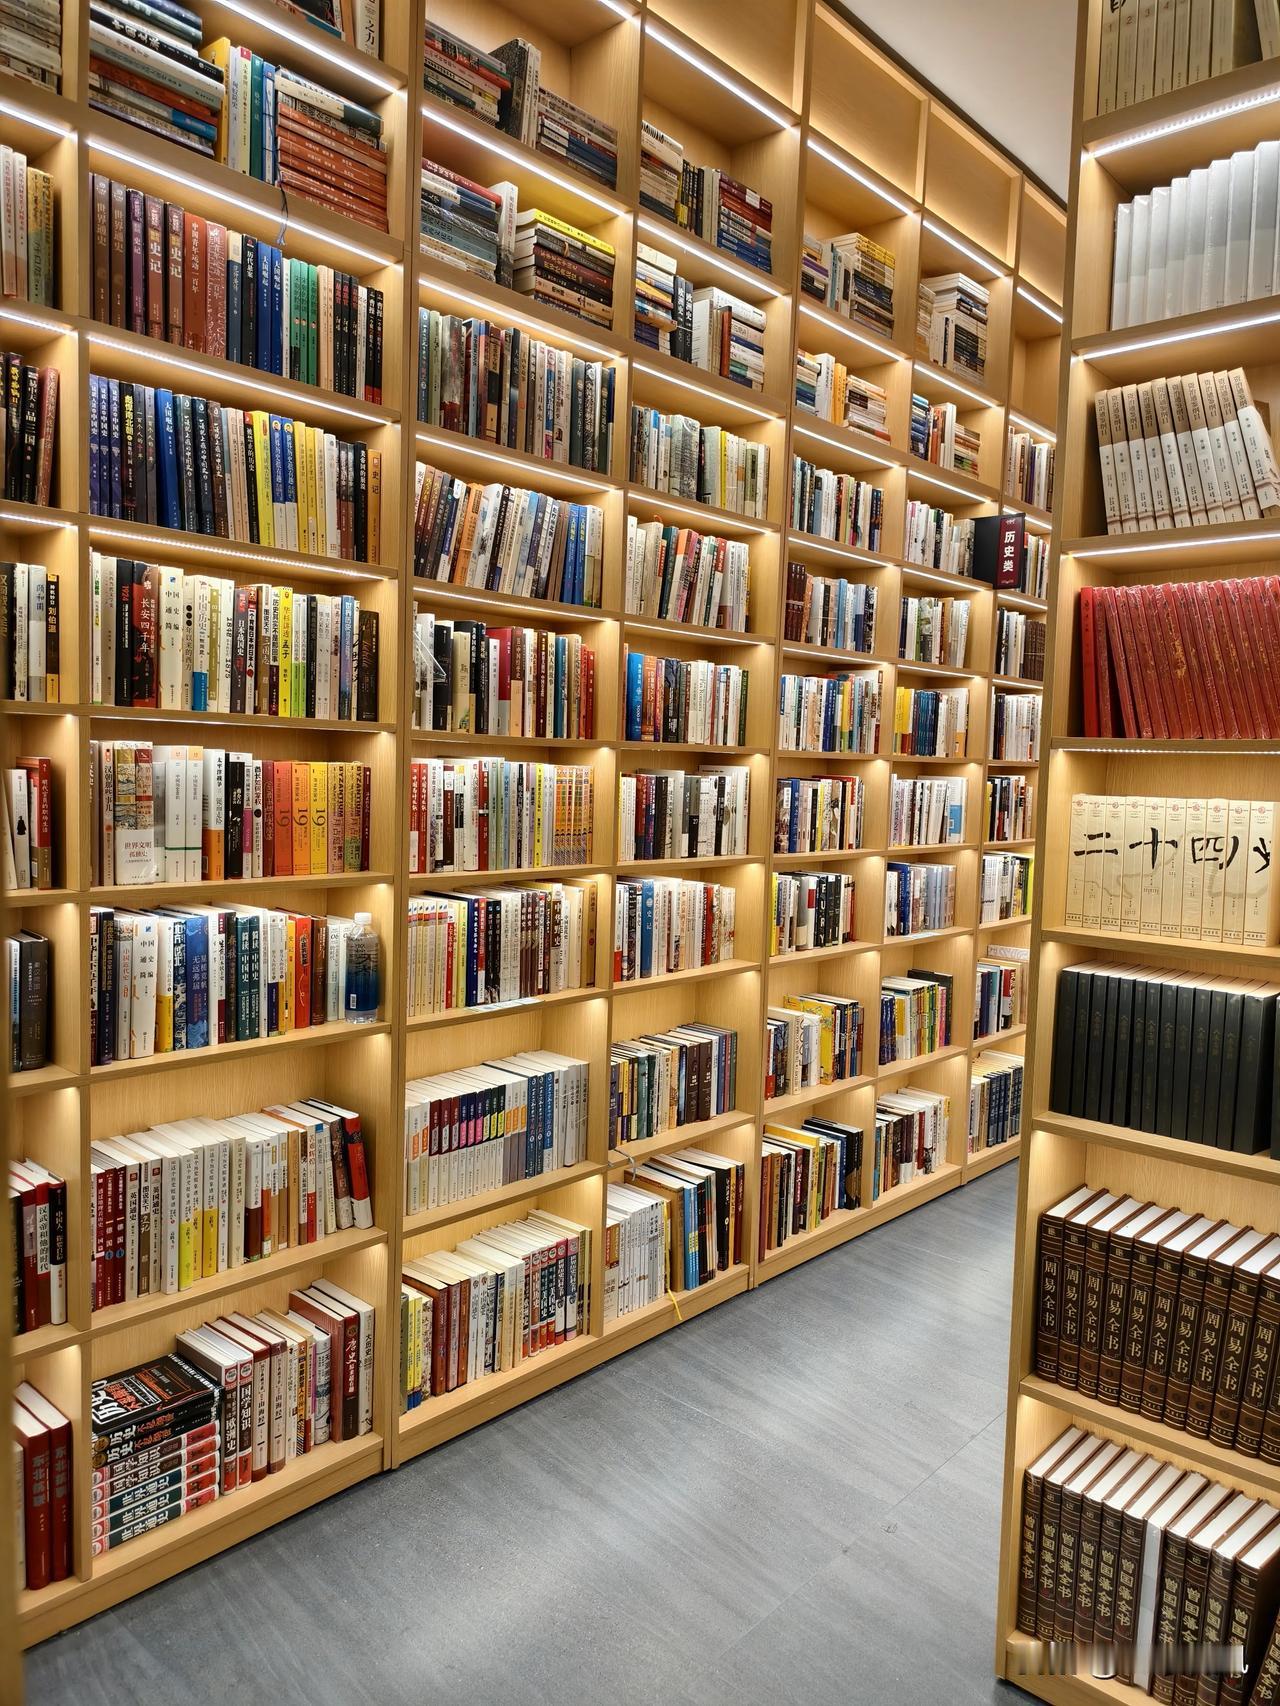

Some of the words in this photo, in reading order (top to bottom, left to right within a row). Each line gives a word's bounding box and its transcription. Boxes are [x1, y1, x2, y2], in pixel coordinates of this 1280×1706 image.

[150, 242, 162, 274] 史记
[170, 247, 183, 278] 史记
[1003, 531, 1016, 572] 历史类
[140, 598, 151, 653] 长安四千年
[294, 807, 309, 826] 19
[312, 808, 326, 826] 19
[1043, 1259, 1057, 1328] 周易全书
[1064, 1267, 1079, 1336] 周易全书
[1085, 1275, 1100, 1344] 周易全书
[1106, 1282, 1123, 1351] 周易全书
[1128, 1289, 1147, 1358] 周易全书
[1150, 1296, 1170, 1366] 周易全书
[1176, 1303, 1196, 1374] 周易全书
[1200, 1311, 1220, 1382] 周易全书
[1224, 1319, 1246, 1392] 周易全书
[1248, 1326, 1273, 1400] 周易全书
[240, 1386, 251, 1431] 国学知识
[113, 1446, 161, 1477] 国学知识
[113, 1461, 161, 1494] 国学知识
[122, 1476, 170, 1507] 世界通史
[121, 1510, 169, 1542] 世界通史
[122, 1493, 170, 1525] 世界通史
[1022, 1513, 1036, 1580] 曾国藩全书
[1039, 1523, 1055, 1589] 曾国藩全书
[1057, 1532, 1075, 1600] 曾国藩全书
[1077, 1540, 1094, 1609] 曾国藩全书
[1096, 1549, 1114, 1618] 曾国藩全书
[1116, 1558, 1135, 1628] 曾国藩全书
